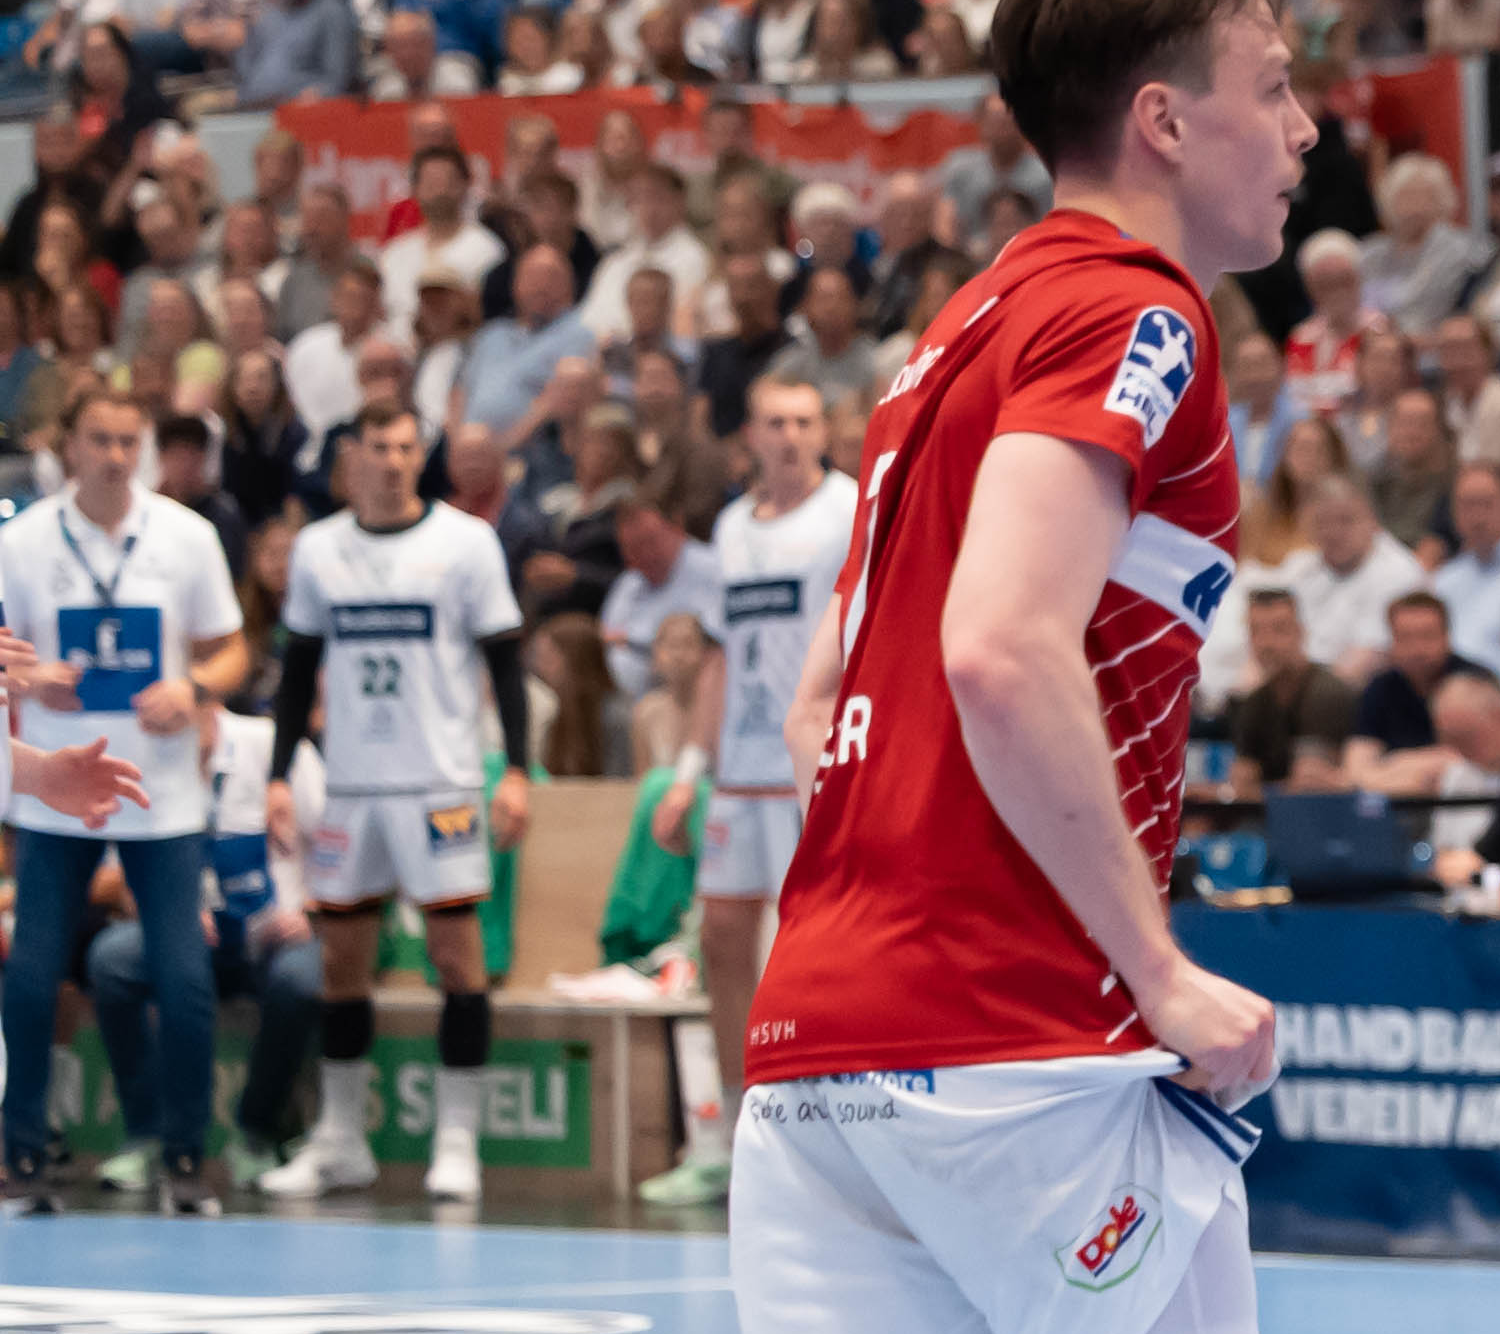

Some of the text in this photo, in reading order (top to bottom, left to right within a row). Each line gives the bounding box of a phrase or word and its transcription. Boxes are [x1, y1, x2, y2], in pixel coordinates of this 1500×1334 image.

[750, 1019, 797, 1046] HSVH
[1271, 1076, 1457, 1148] VEREIN
[1074, 1196, 1139, 1272] Dole
